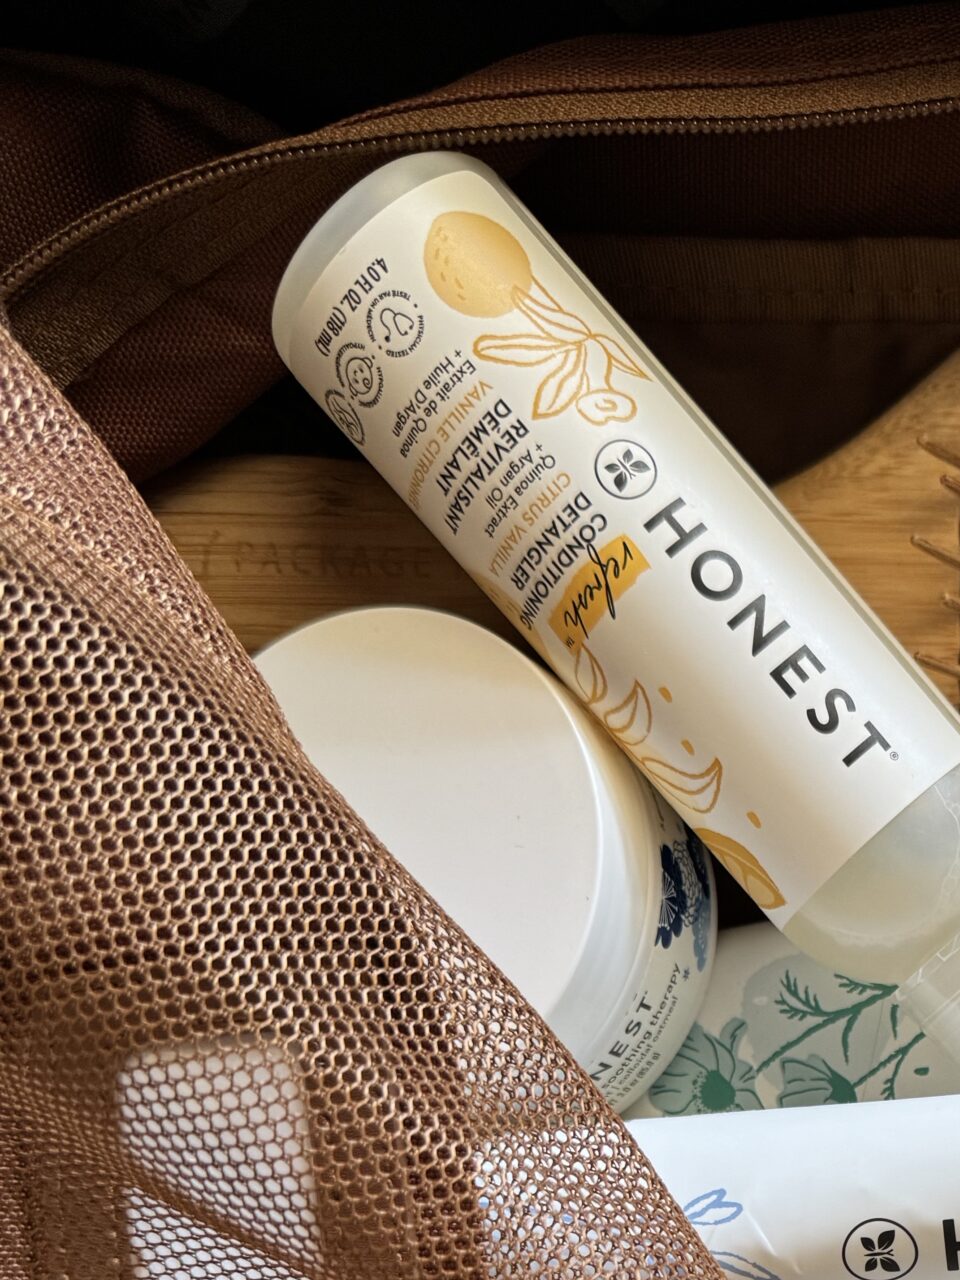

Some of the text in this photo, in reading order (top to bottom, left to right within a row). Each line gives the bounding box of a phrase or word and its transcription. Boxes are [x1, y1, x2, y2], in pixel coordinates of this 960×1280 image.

[314, 257, 389, 357] 4.0 FL OZ. (118 mL)
[409, 314, 425, 353] PHYSICIAN
[392, 388, 428, 438] D'Argan
[399, 359, 477, 459] Extrait de Quinoa
[423, 356, 455, 391] Huile
[436, 380, 494, 443] VANILLE
[436, 398, 513, 497] DÉMÊLANT
[444, 418, 530, 536] REVITALISANT
[500, 449, 534, 488] Argan
[484, 454, 556, 539] Quinoa Extract
[485, 487, 504, 511] Oil
[488, 472, 571, 578] CITRUS VANILLA
[511, 491, 593, 592] DETANGLER
[520, 513, 608, 631] CONDITIONING
[590, 994, 653, 1081] NEST
[650, 963, 681, 1027] therapy
